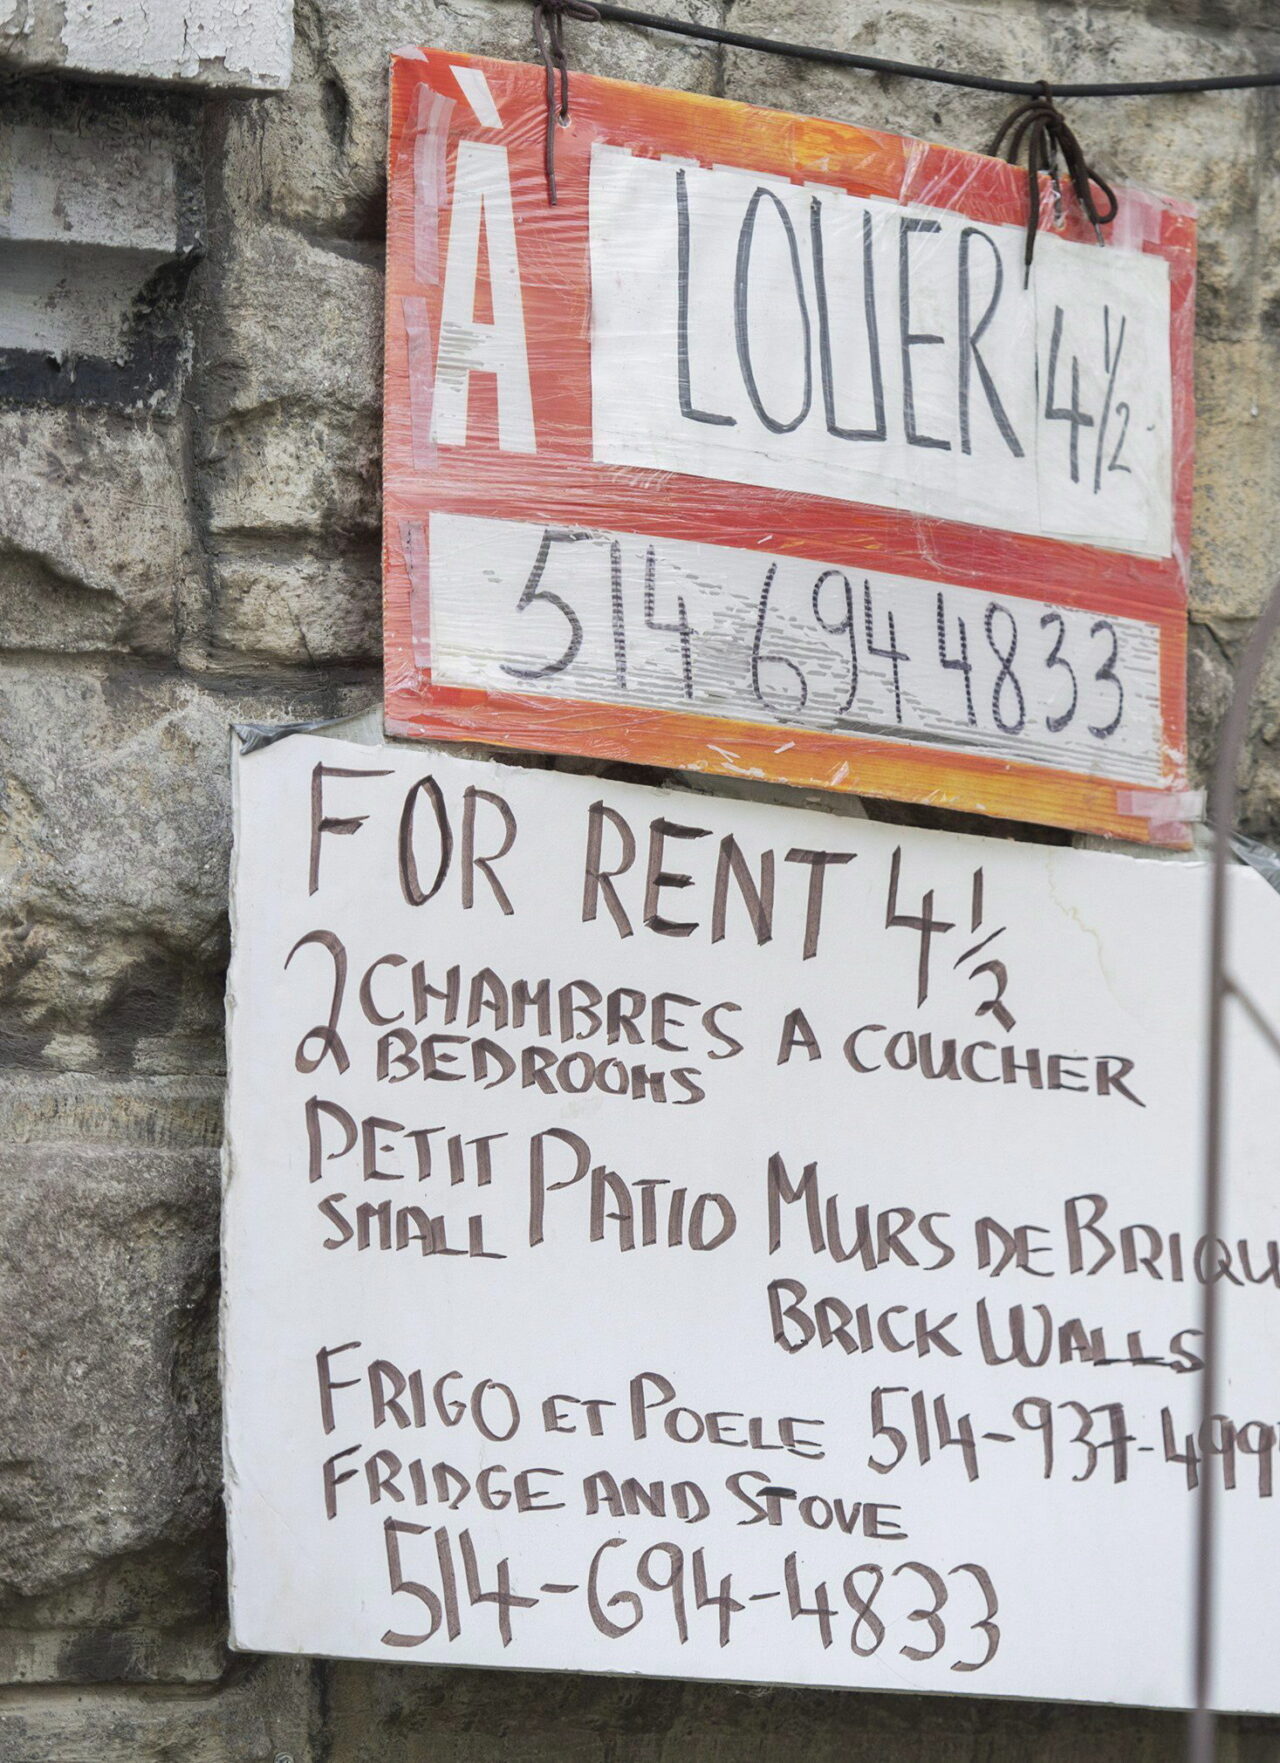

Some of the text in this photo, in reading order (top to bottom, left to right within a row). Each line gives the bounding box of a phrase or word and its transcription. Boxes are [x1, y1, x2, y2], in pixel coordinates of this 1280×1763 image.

[432, 64, 538, 454] À
[675, 168, 1026, 459] LOUER
[499, 528, 1125, 739] 514 694 4833
[309, 761, 518, 916] FOR
[582, 800, 857, 960] RENT
[284, 929, 1147, 1108] 2 CHAMBRES A COUCHER
[377, 1027, 706, 1105] BEDROOMS
[305, 1095, 508, 1187] PETIT
[529, 1127, 737, 1252] PATIO
[768, 1151, 955, 1272] MURS
[975, 1216, 1055, 1277] DE
[317, 1192, 508, 1259] SMALL
[316, 1341, 520, 1442] FRIGO
[542, 1394, 616, 1437] ET
[630, 1371, 826, 1460] POELE
[768, 1278, 1206, 1374] BRICK WALLS
[323, 1445, 909, 1540] FRIDGE AND STOVE
[381, 1516, 1000, 1673] 514-694-4833
